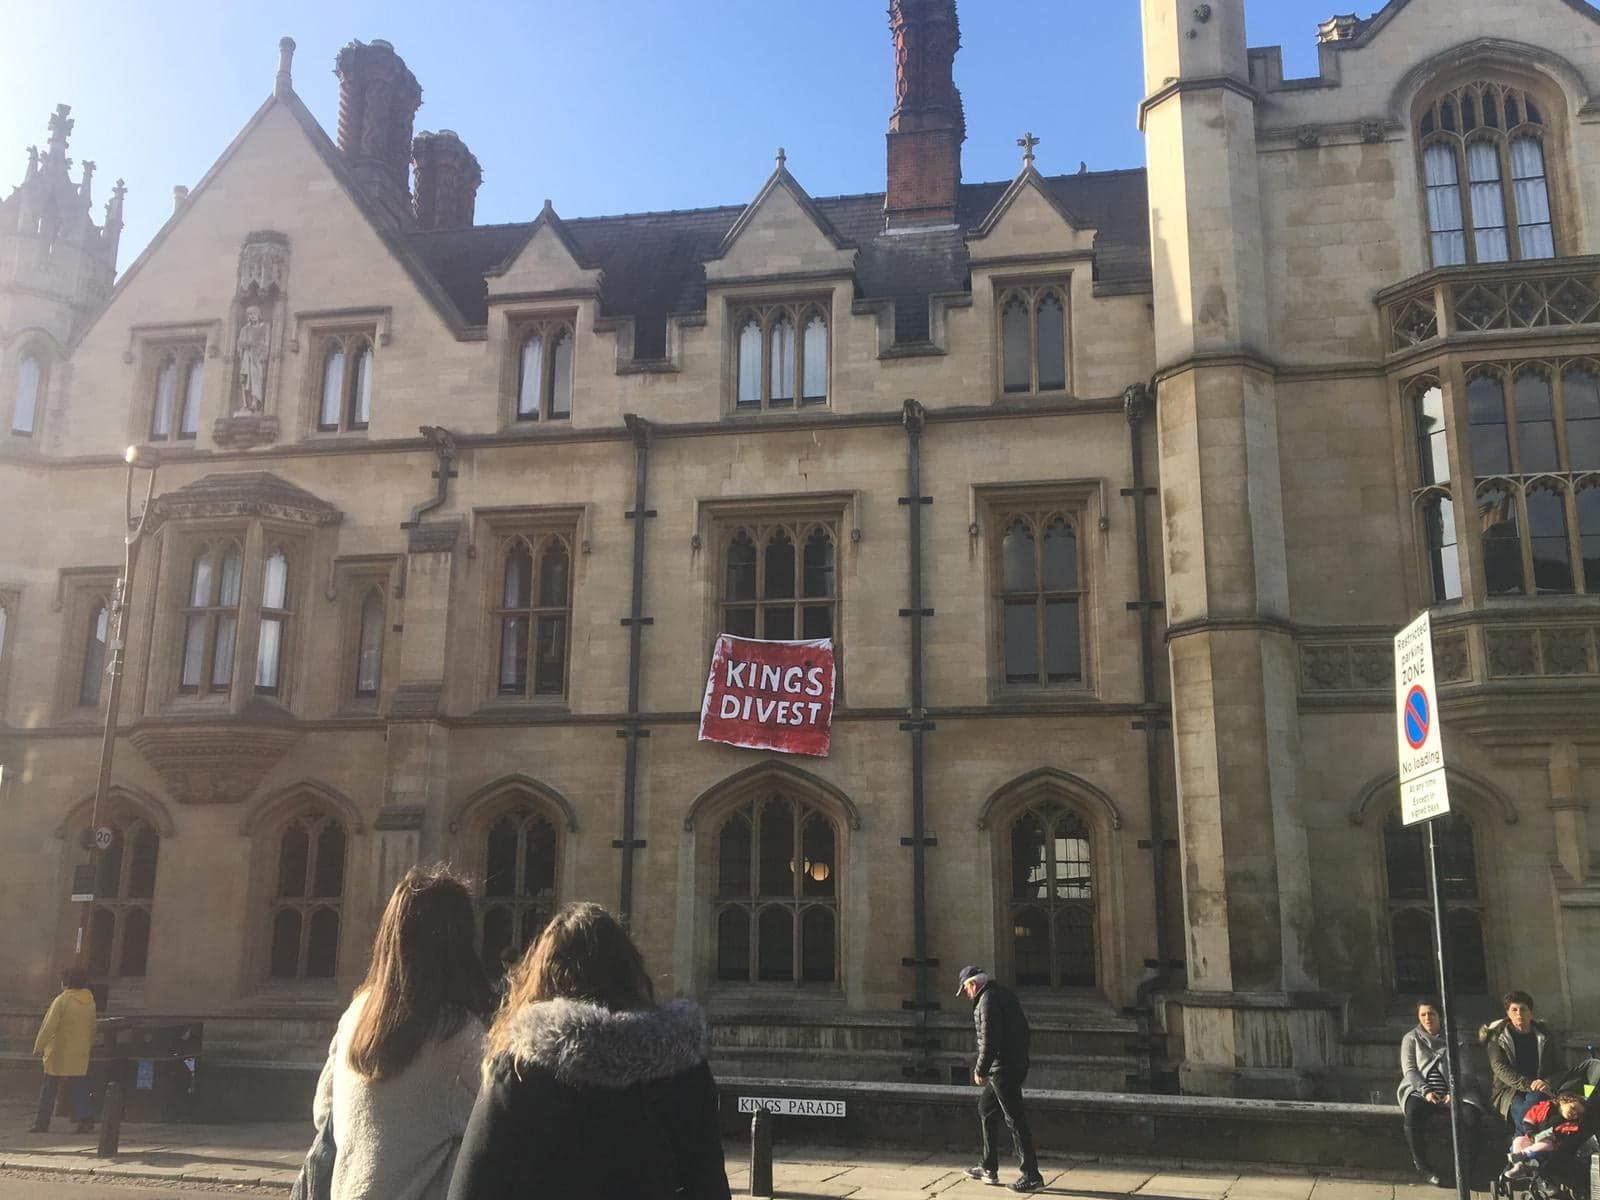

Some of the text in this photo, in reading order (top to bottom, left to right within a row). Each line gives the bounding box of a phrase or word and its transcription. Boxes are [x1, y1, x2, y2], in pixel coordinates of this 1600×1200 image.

[726, 660, 824, 696] KINGS
[1402, 658, 1425, 685] ZONE
[720, 694, 822, 725] DIVEST
[1402, 751, 1440, 774] No loading
[96, 831, 110, 844] 20
[741, 1099, 844, 1115] KINGS PARADE
